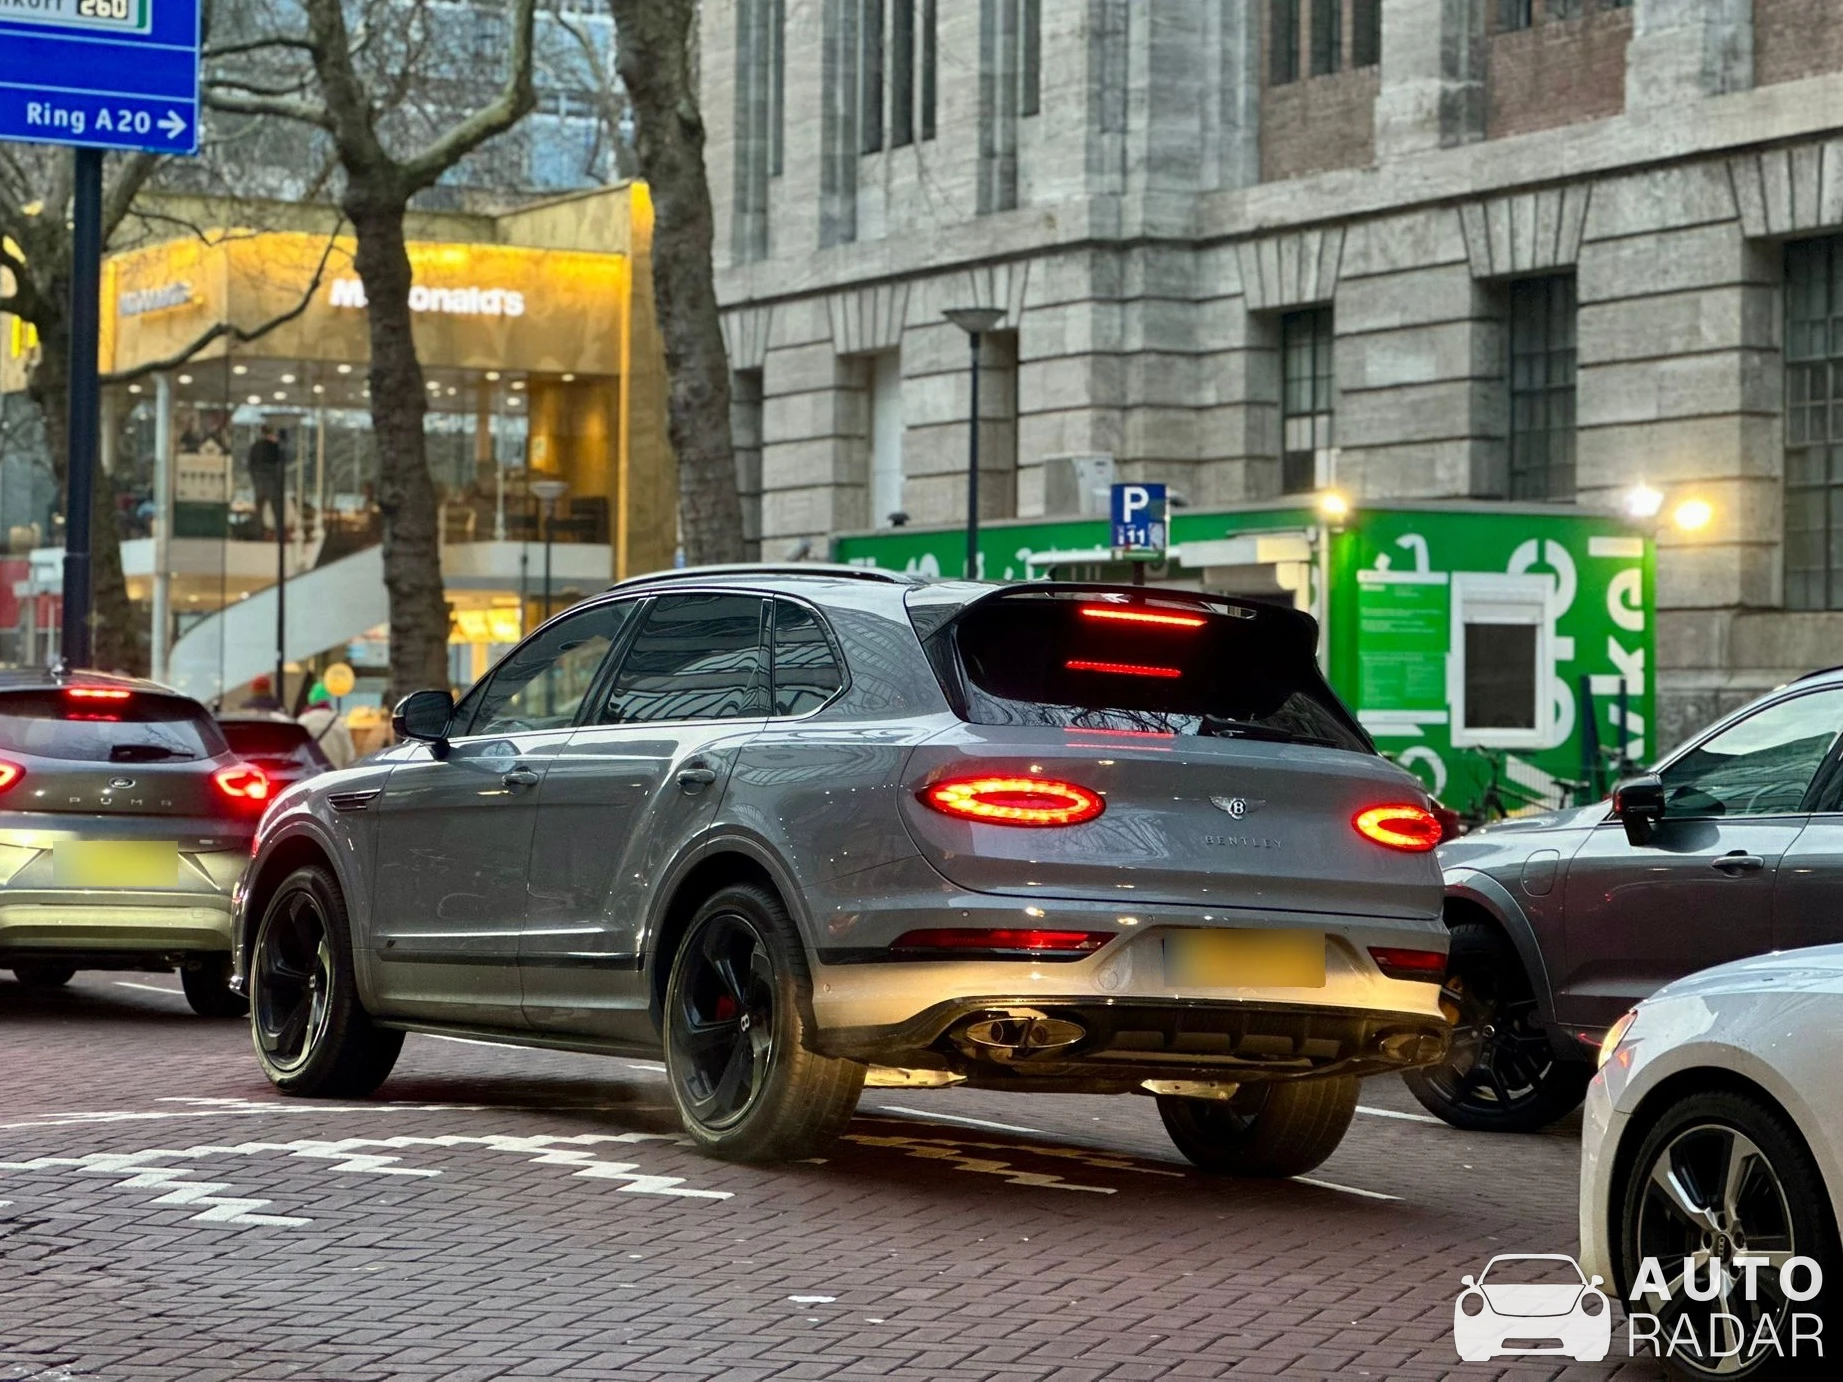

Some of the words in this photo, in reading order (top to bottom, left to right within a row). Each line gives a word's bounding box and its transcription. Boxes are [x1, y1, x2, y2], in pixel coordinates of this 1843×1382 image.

[27, 102, 86, 133] Ring
[329, 278, 525, 317] Monald's
[1123, 486, 1150, 524] P
[1233, 801, 1244, 814] B
[1205, 835, 1282, 849] BENTLEY
